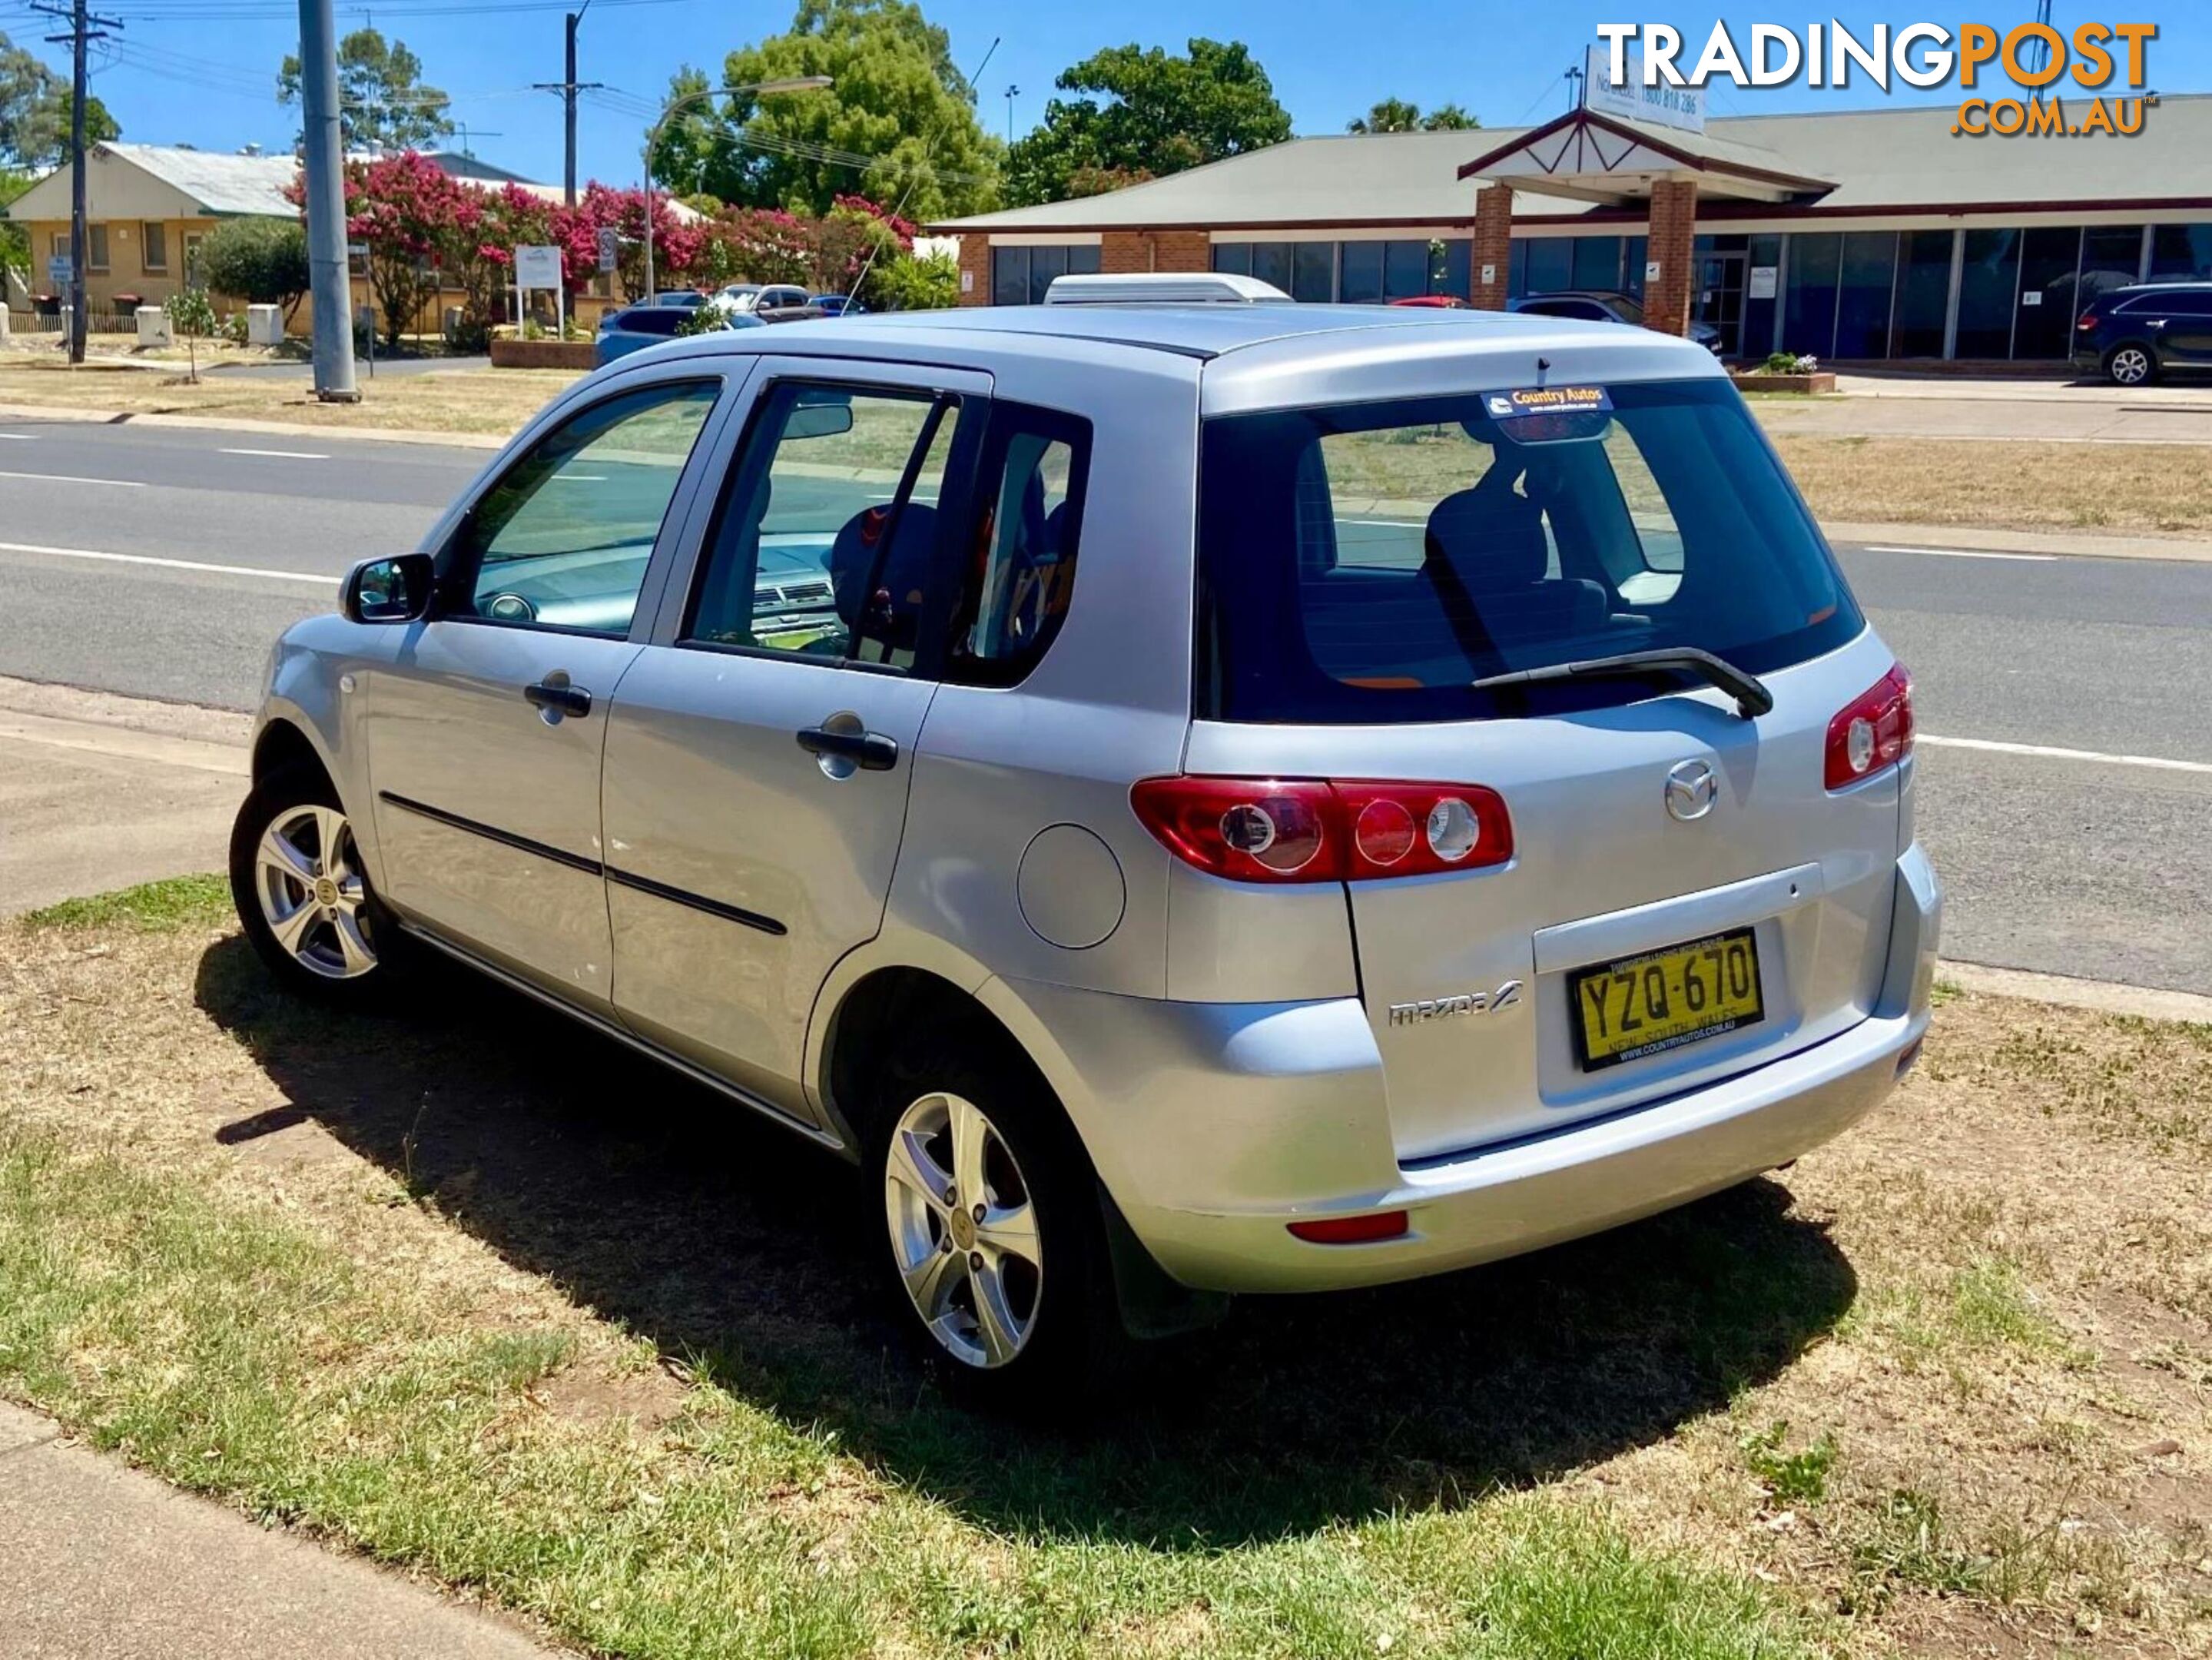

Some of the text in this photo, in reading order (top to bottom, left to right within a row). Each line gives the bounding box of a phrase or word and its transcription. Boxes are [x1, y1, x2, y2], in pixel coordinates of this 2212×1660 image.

[1512, 387, 1603, 405] Country Autos
[1609, 1007, 1738, 1053] NEW SOUTH WALES
[1620, 1020, 1736, 1061] WWW.COUNTRYAUTOS.COM.AU
